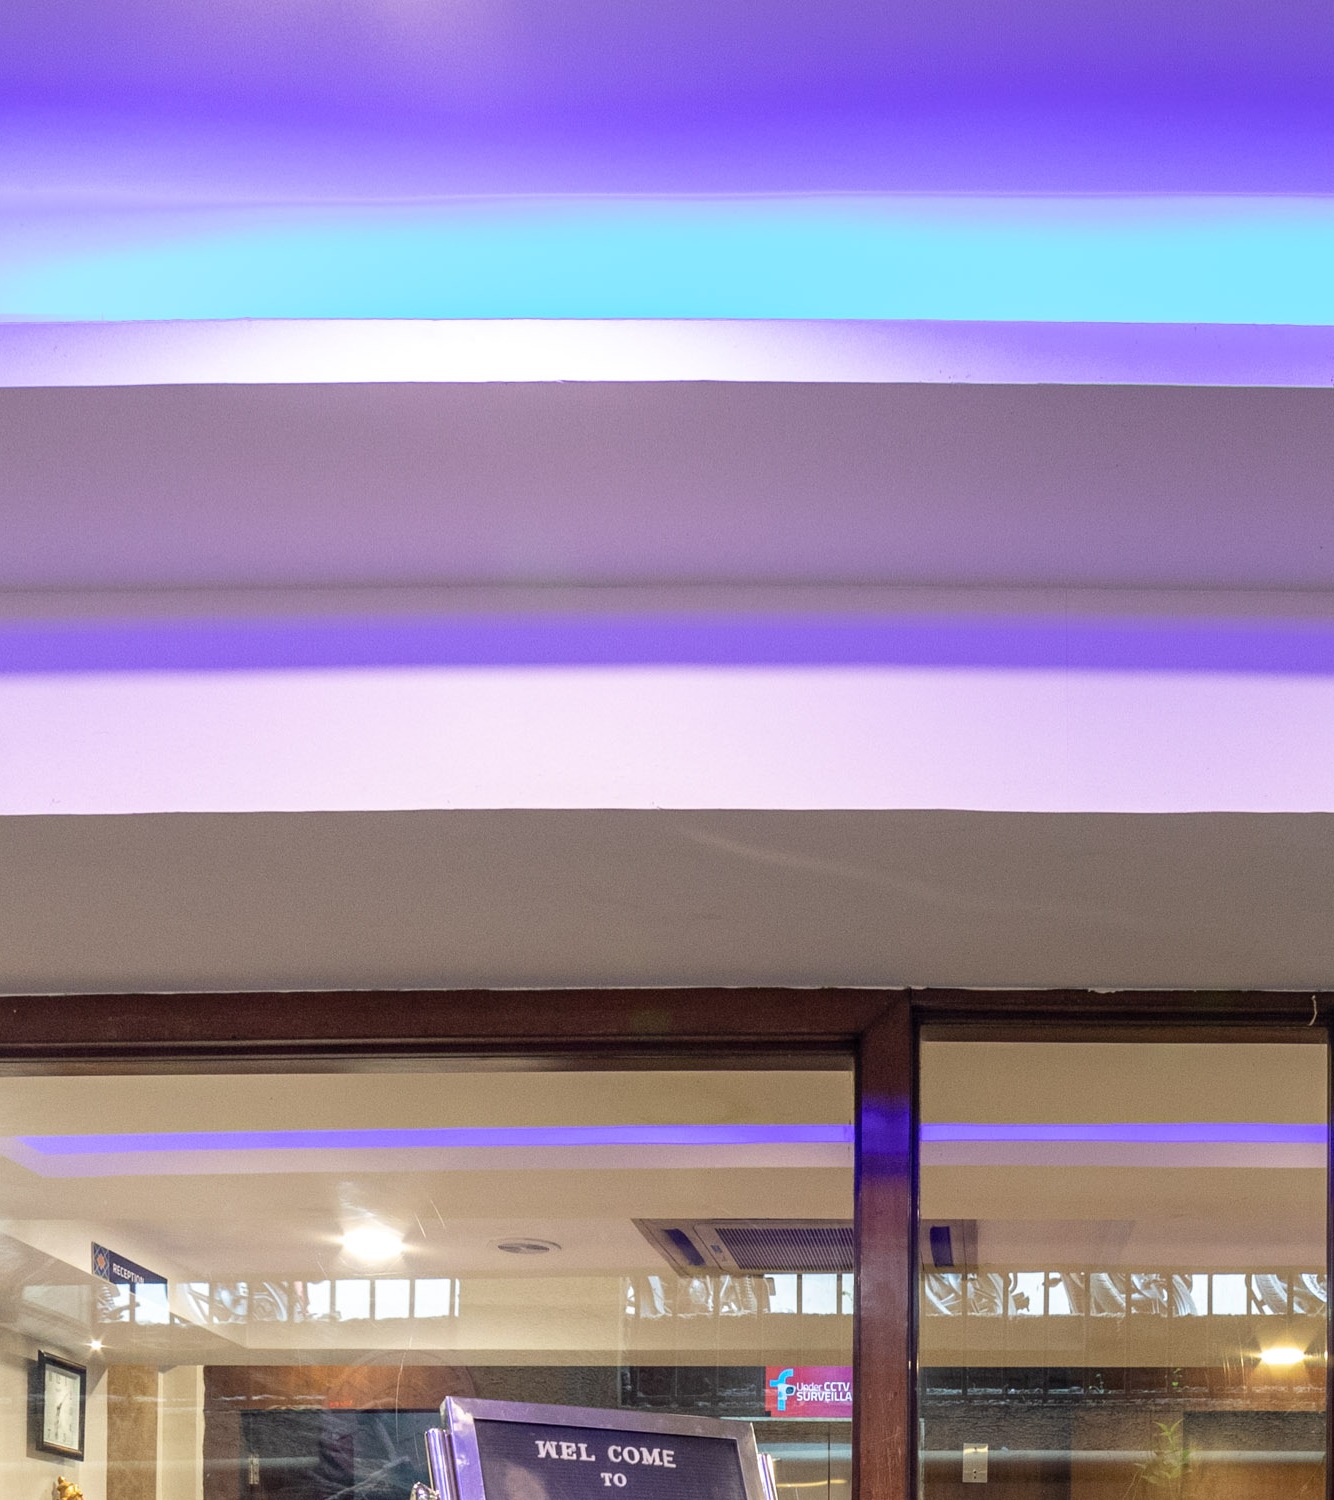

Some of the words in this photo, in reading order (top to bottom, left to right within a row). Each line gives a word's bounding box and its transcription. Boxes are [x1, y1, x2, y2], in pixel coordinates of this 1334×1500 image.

[112, 1262, 145, 1284] RECEPTION
[796, 1382, 822, 1391] Under
[824, 1381, 850, 1392] CCTV
[535, 1440, 596, 1462] WEL
[607, 1445, 677, 1468] COME
[600, 1472, 628, 1488] TO
